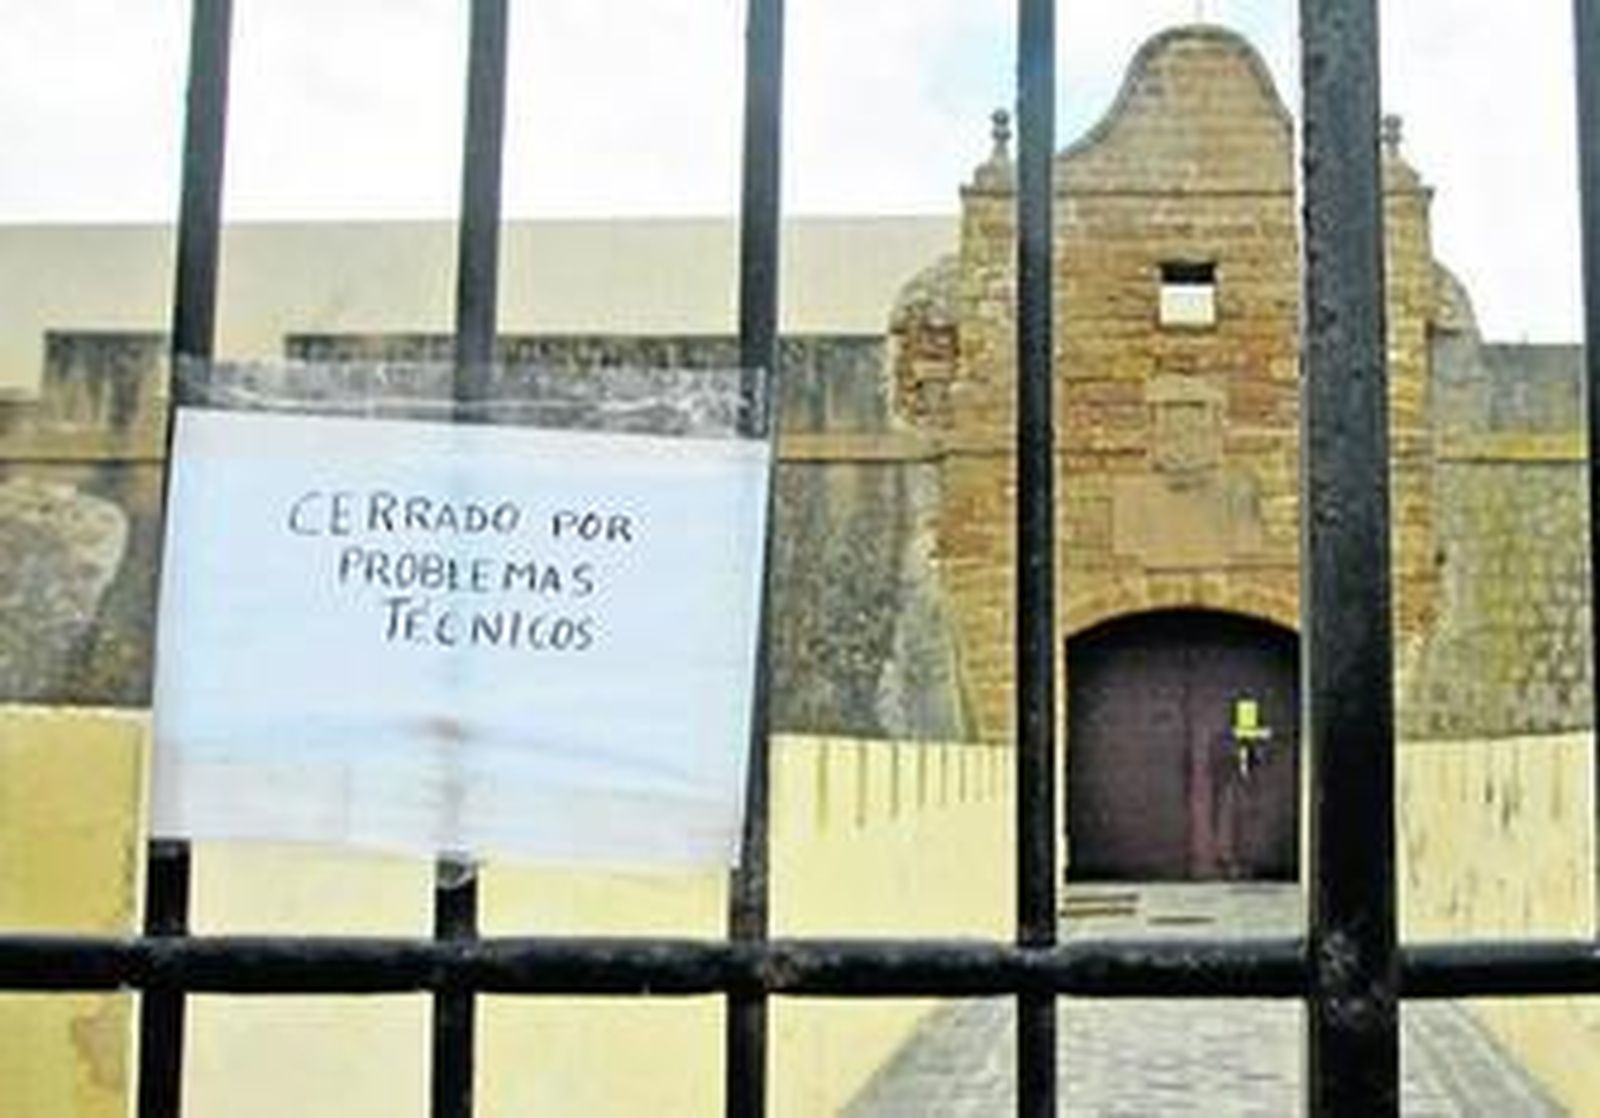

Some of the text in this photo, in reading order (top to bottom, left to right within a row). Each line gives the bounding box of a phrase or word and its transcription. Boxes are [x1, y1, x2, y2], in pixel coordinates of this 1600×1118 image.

[289, 491, 634, 543] CERRADO POR
[339, 547, 595, 595] PROBLEMAS
